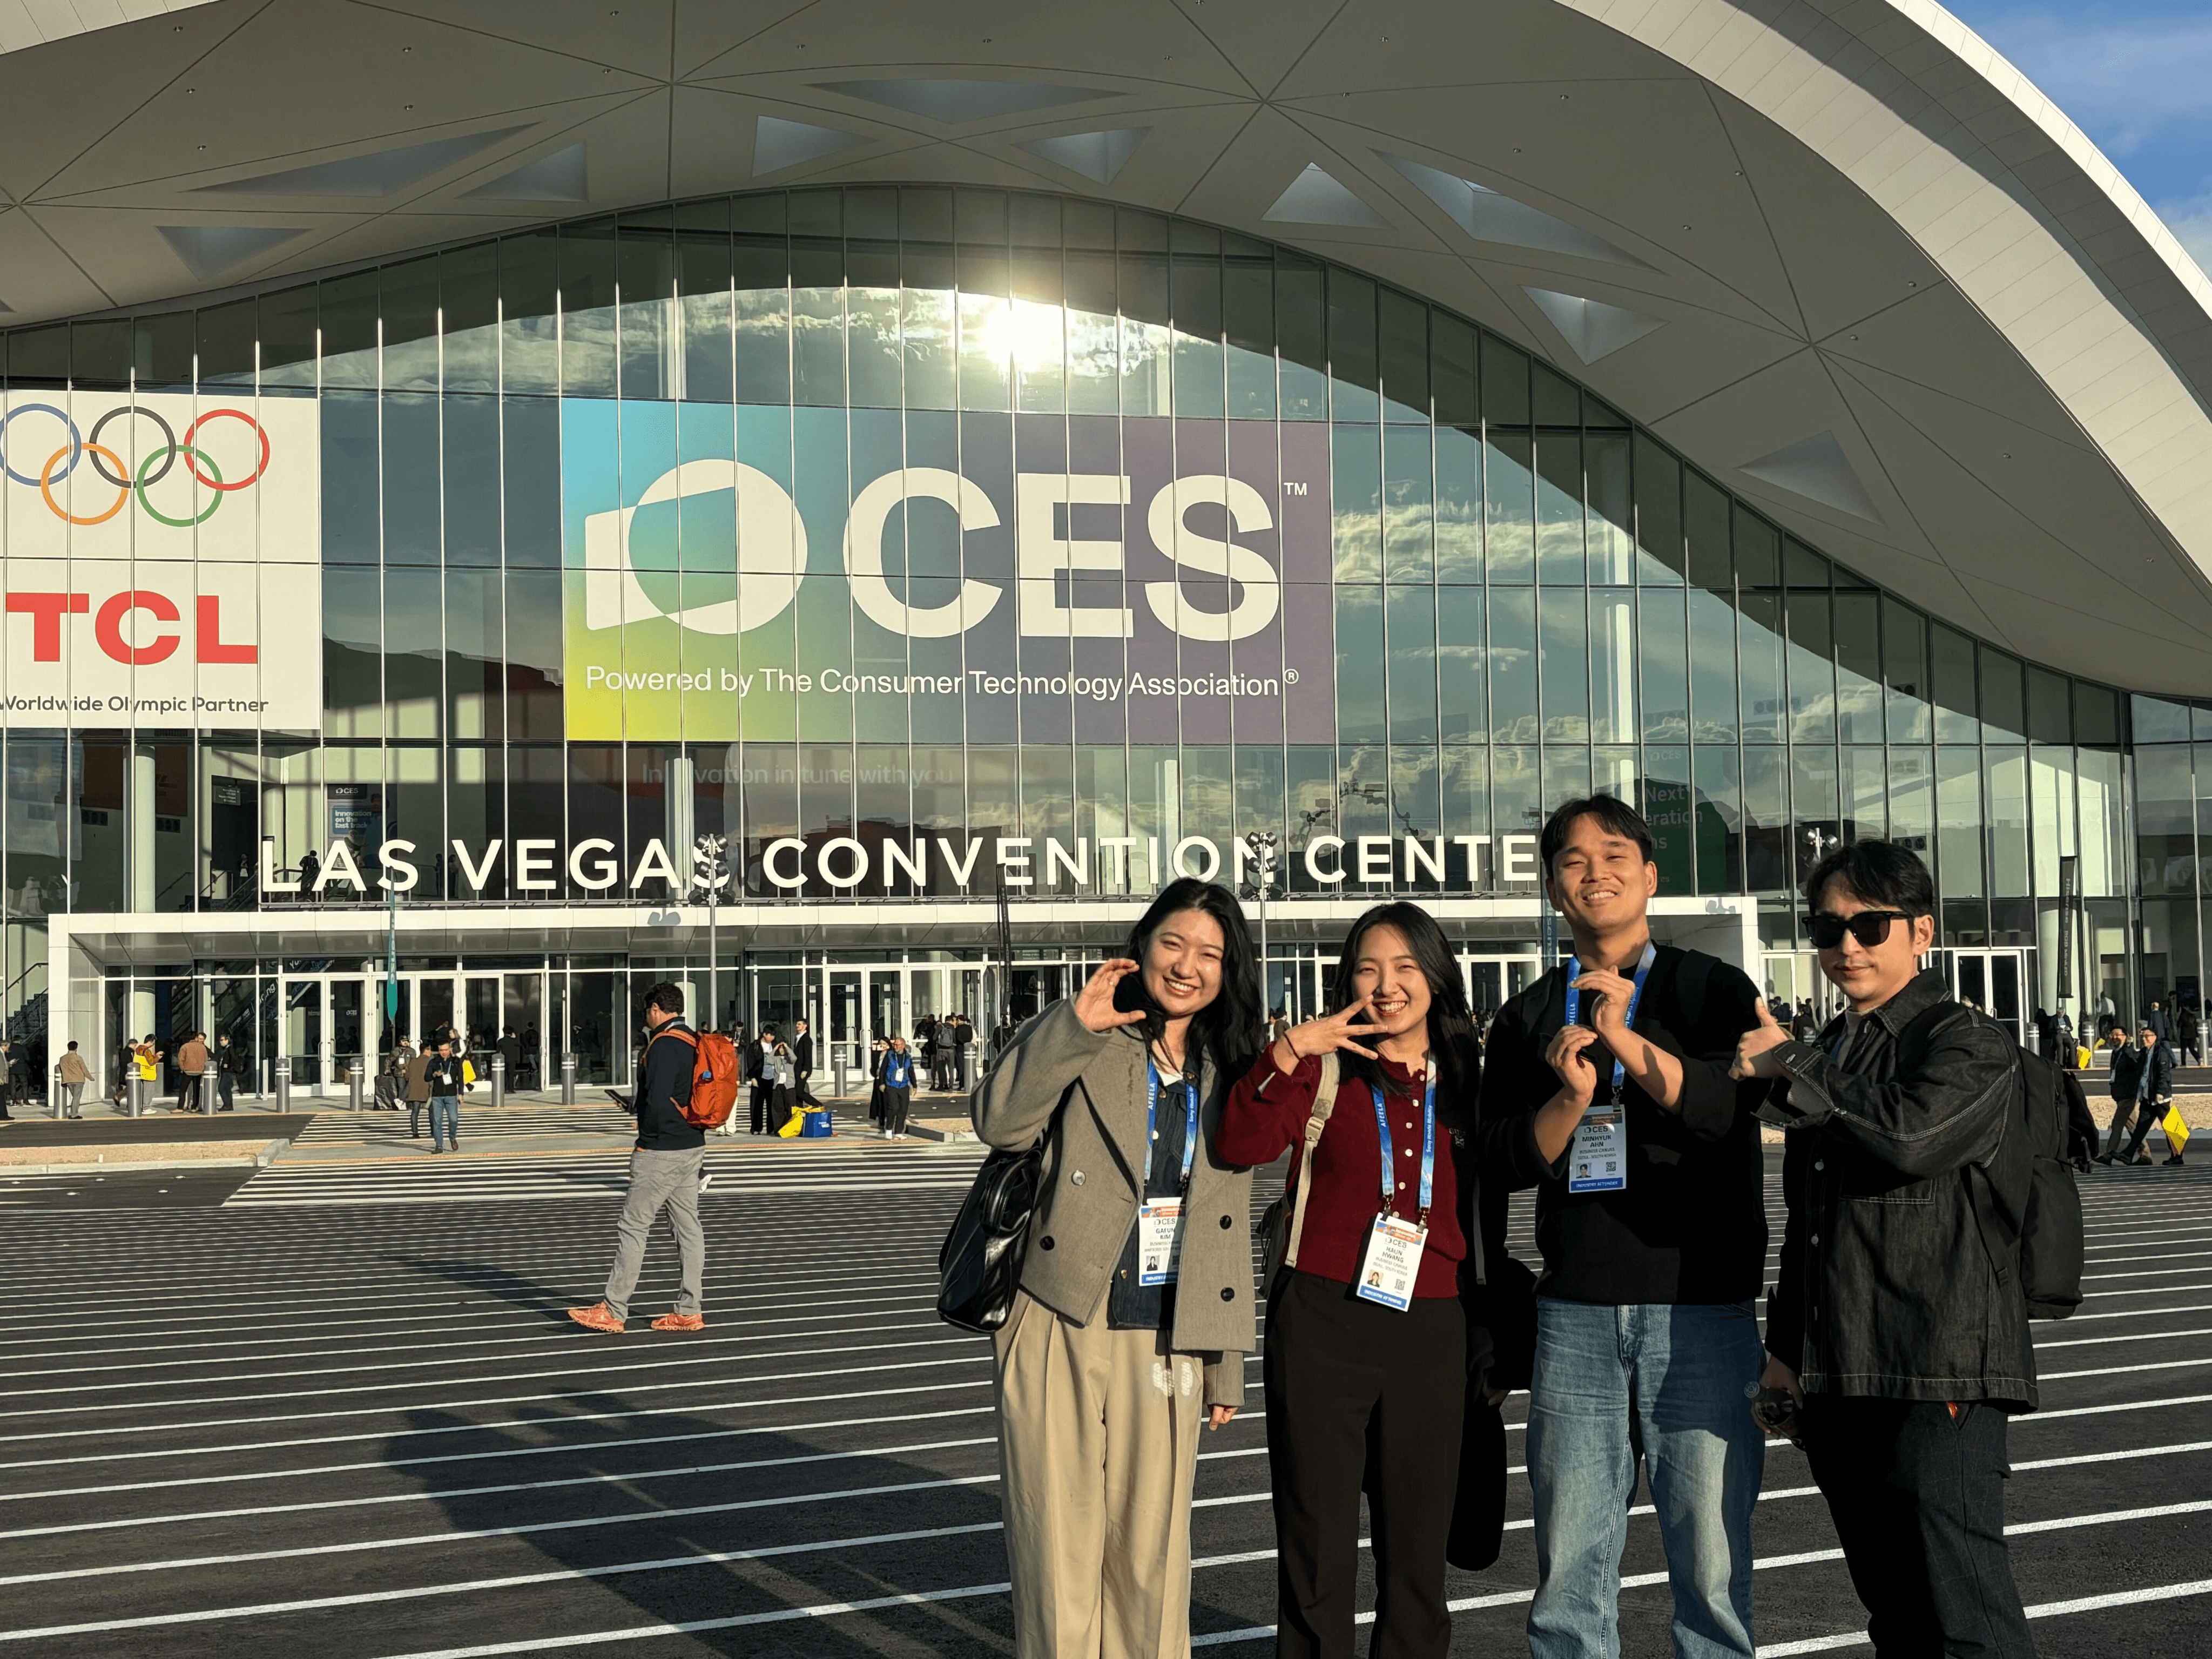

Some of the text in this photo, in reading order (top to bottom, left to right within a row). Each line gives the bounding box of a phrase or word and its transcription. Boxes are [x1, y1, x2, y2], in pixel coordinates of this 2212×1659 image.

[843, 467, 1280, 642] CES
[6, 590, 258, 665] TCL
[586, 665, 712, 691] Powered
[720, 667, 754, 698] by
[759, 668, 812, 692] The
[820, 669, 962, 694] Consumer
[969, 670, 1123, 701] Technology
[0, 696, 269, 715] Worldwide Olympic Partner
[642, 763, 953, 788] Invation in tune with you
[1646, 786, 1685, 802] Next
[1645, 808, 1703, 826] eration
[262, 835, 1537, 892] LAS VEGAS CONVENTION CENTE
[1377, 1103, 1387, 1128] AFEELA
[1393, 1239, 1407, 1249] CES
